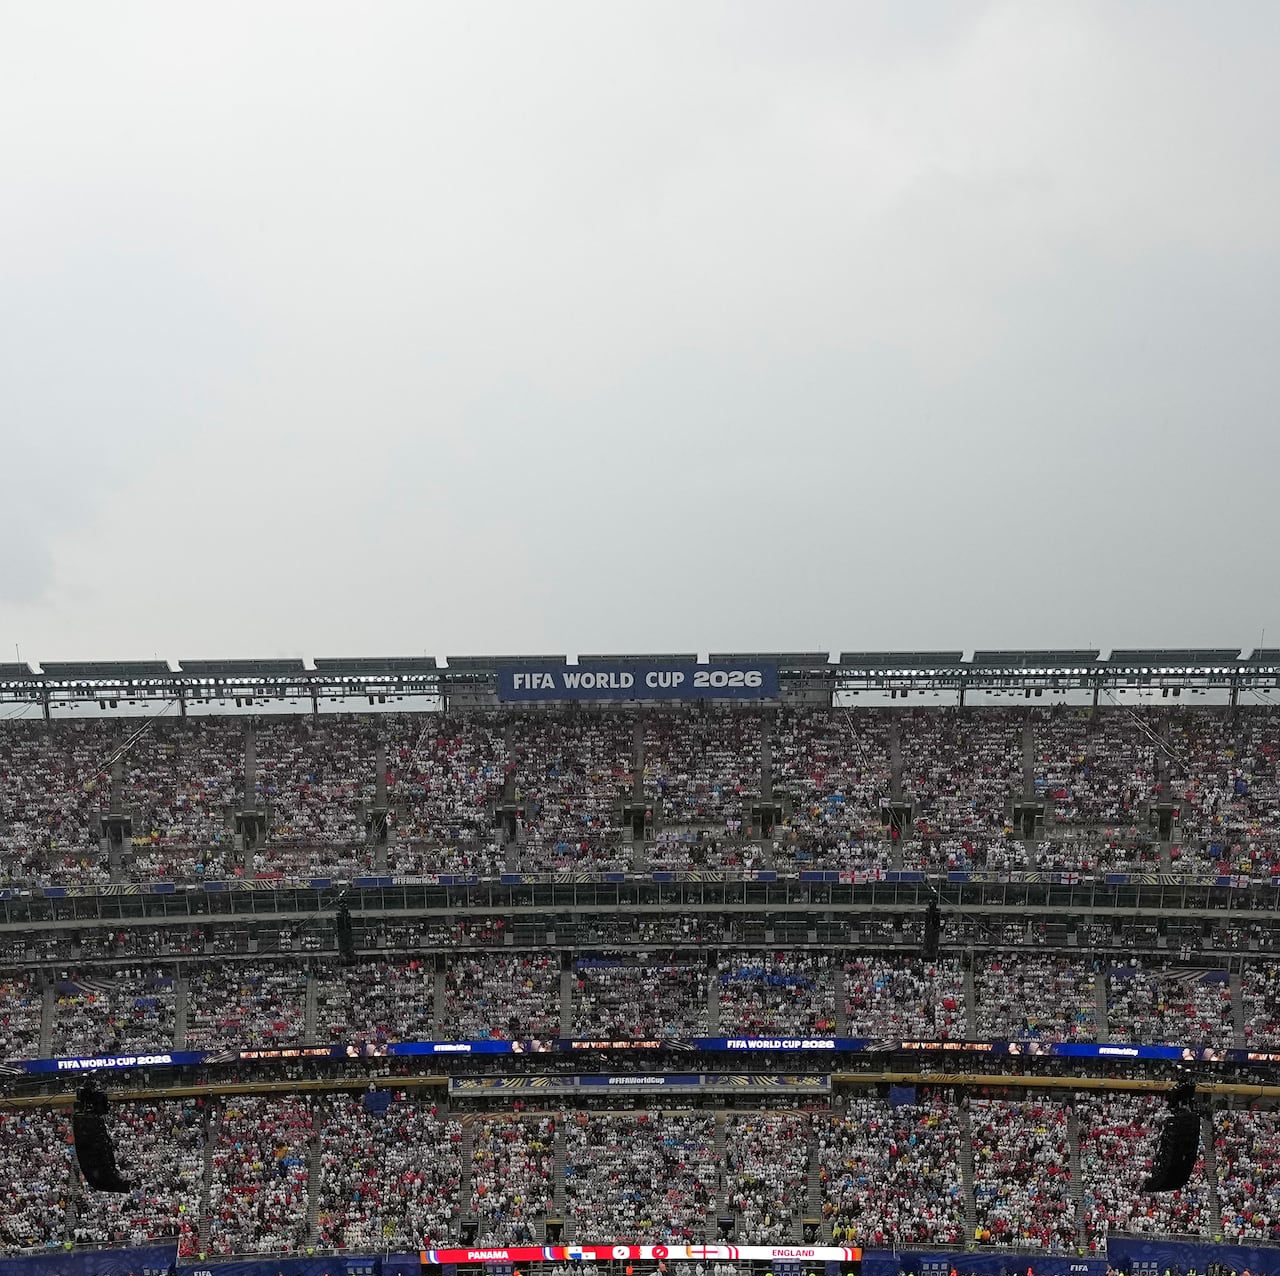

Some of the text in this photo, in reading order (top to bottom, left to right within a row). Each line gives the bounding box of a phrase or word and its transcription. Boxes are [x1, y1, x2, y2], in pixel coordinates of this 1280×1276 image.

[513, 671, 762, 689] FIFA WORLD CUP 2026
[727, 1040, 836, 1049] FIFA WORLD CUP 2026
[1248, 1053, 1268, 1061] NEW
[58, 1055, 172, 1069] FIFA WORLD CUP 2026
[609, 1076, 664, 1085] #FIFAWorldCup
[467, 1249, 814, 1260] PANAMA ENGLAND
[1070, 1264, 1088, 1272] FIFA
